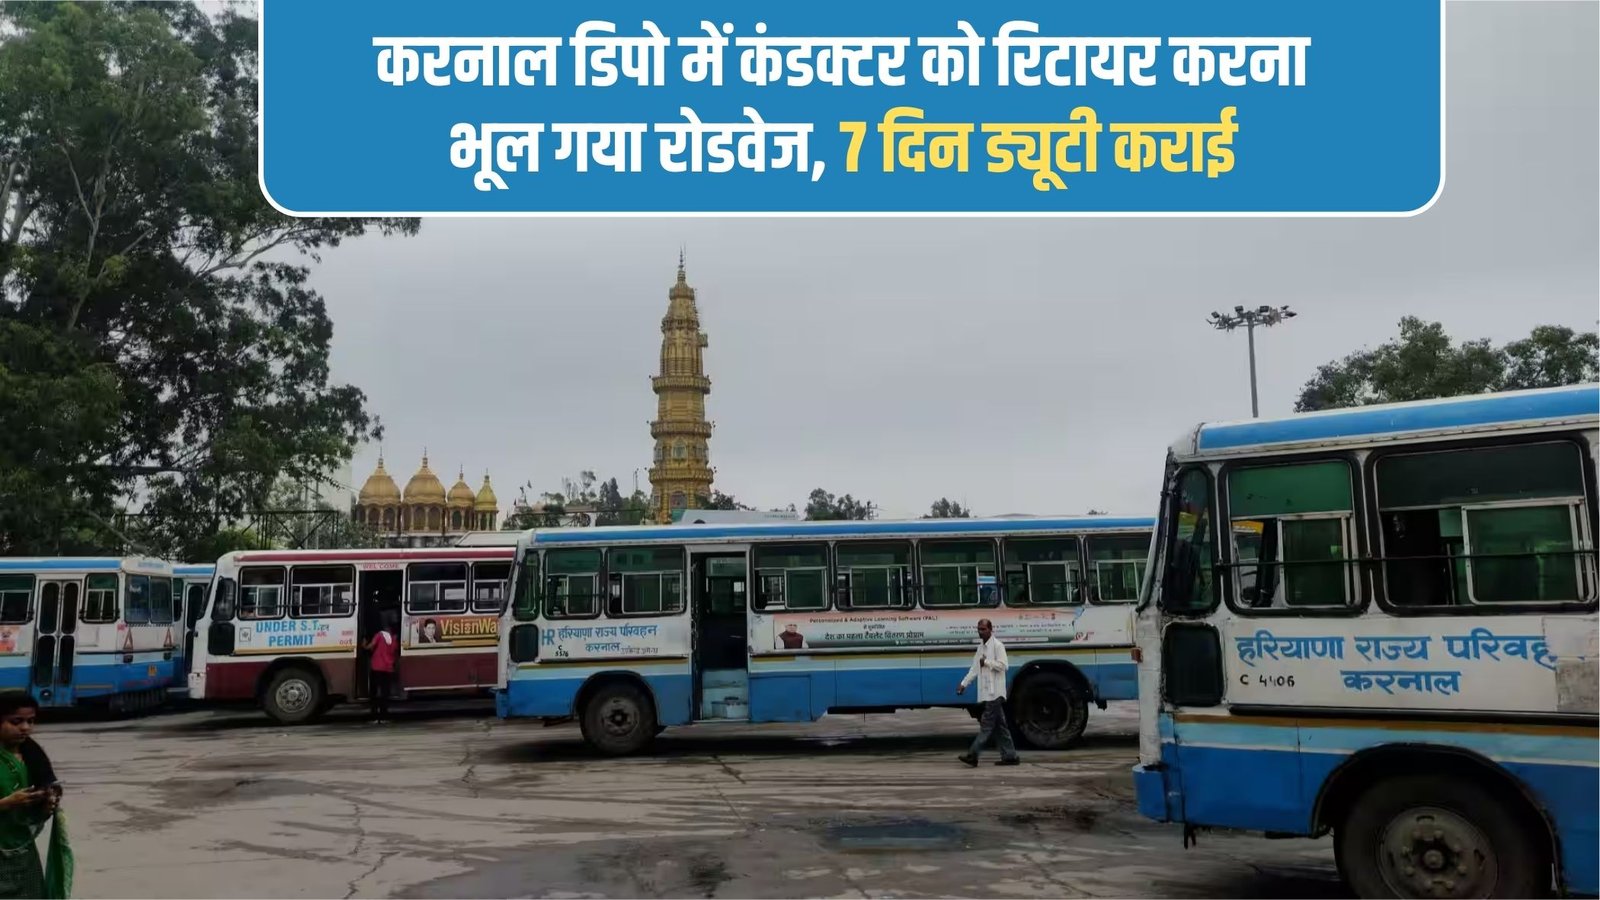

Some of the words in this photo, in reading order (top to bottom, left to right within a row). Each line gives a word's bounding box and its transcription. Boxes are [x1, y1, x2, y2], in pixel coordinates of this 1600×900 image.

[256, 620, 295, 633] UNDER
[440, 618, 499, 635] VisionWa
[557, 625, 593, 641] हरियाणा
[595, 627, 617, 638] राज्य
[619, 623, 658, 639] परिवहन
[268, 635, 315, 647] PERMIT
[541, 629, 555, 646] HR
[836, 632, 845, 640] का
[585, 642, 621, 653] करनाल
[1235, 630, 1344, 667] हरियाणा
[1355, 636, 1431, 661] राज्य
[1442, 627, 1585, 671] परिवह
[1240, 674, 1249, 685] C
[1340, 670, 1462, 695] करनाल
